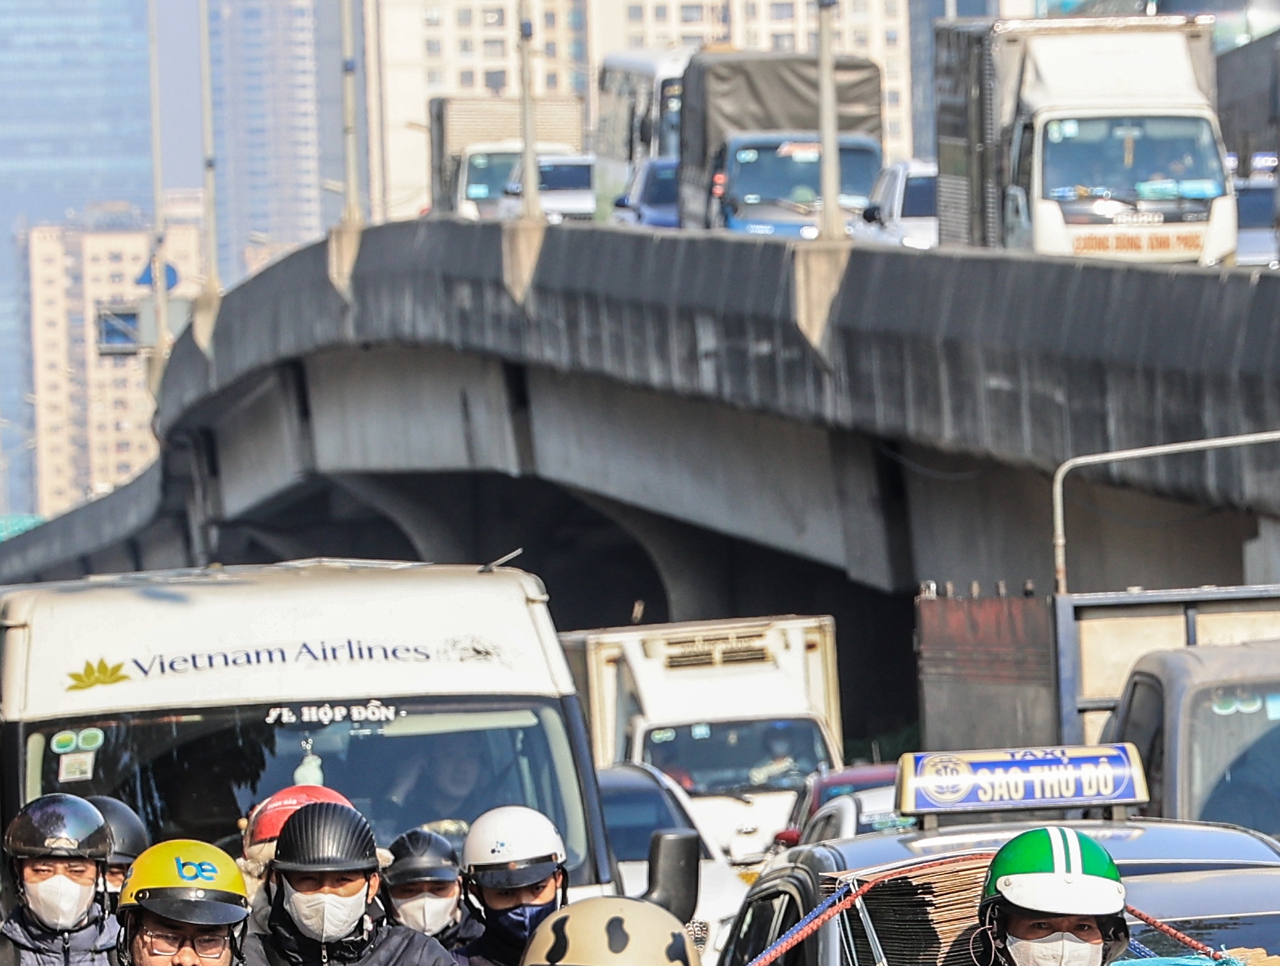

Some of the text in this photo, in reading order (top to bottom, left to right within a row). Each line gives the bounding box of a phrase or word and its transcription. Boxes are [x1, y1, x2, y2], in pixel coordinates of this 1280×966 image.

[132, 638, 432, 677] Vietnam Airlines
[975, 756, 1115, 803] SAO THỦ ĐÔ
[174, 856, 219, 882] be
